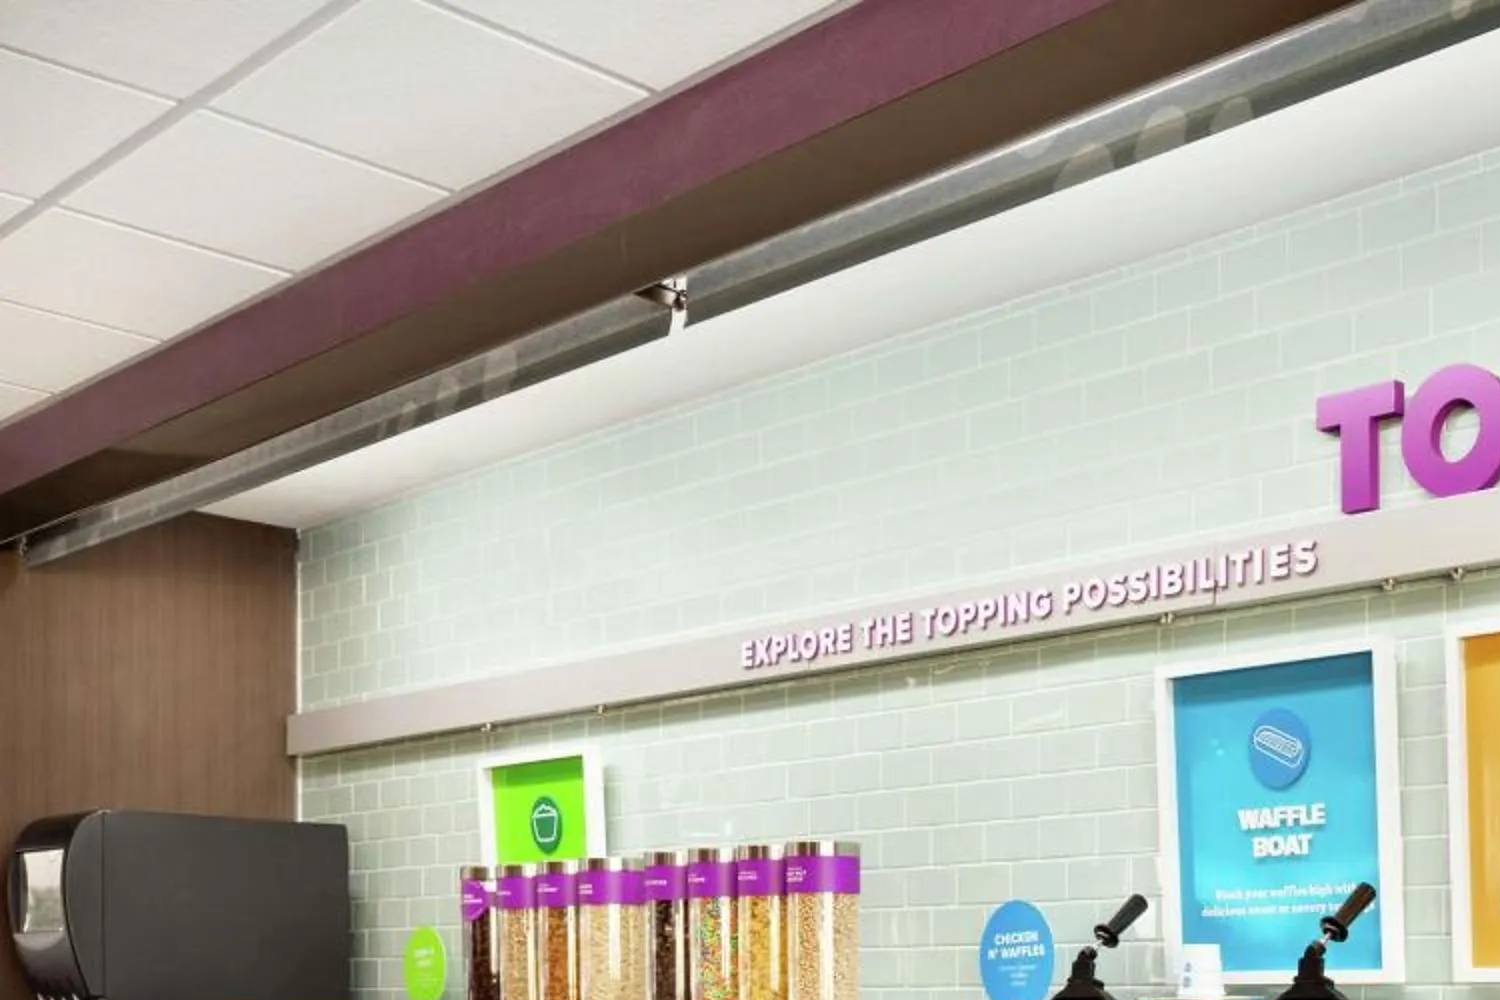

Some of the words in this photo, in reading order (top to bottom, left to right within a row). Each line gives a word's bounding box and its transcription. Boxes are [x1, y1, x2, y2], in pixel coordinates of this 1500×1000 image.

[741, 623, 852, 668] EXPLORE
[861, 611, 914, 649] THE
[921, 587, 1053, 639] TOPPING
[1063, 540, 1319, 616] POSSIBILITIES
[1237, 802, 1326, 830] WAFFLE
[1252, 833, 1313, 858] BOAT
[994, 930, 1039, 946] CHICKEN
